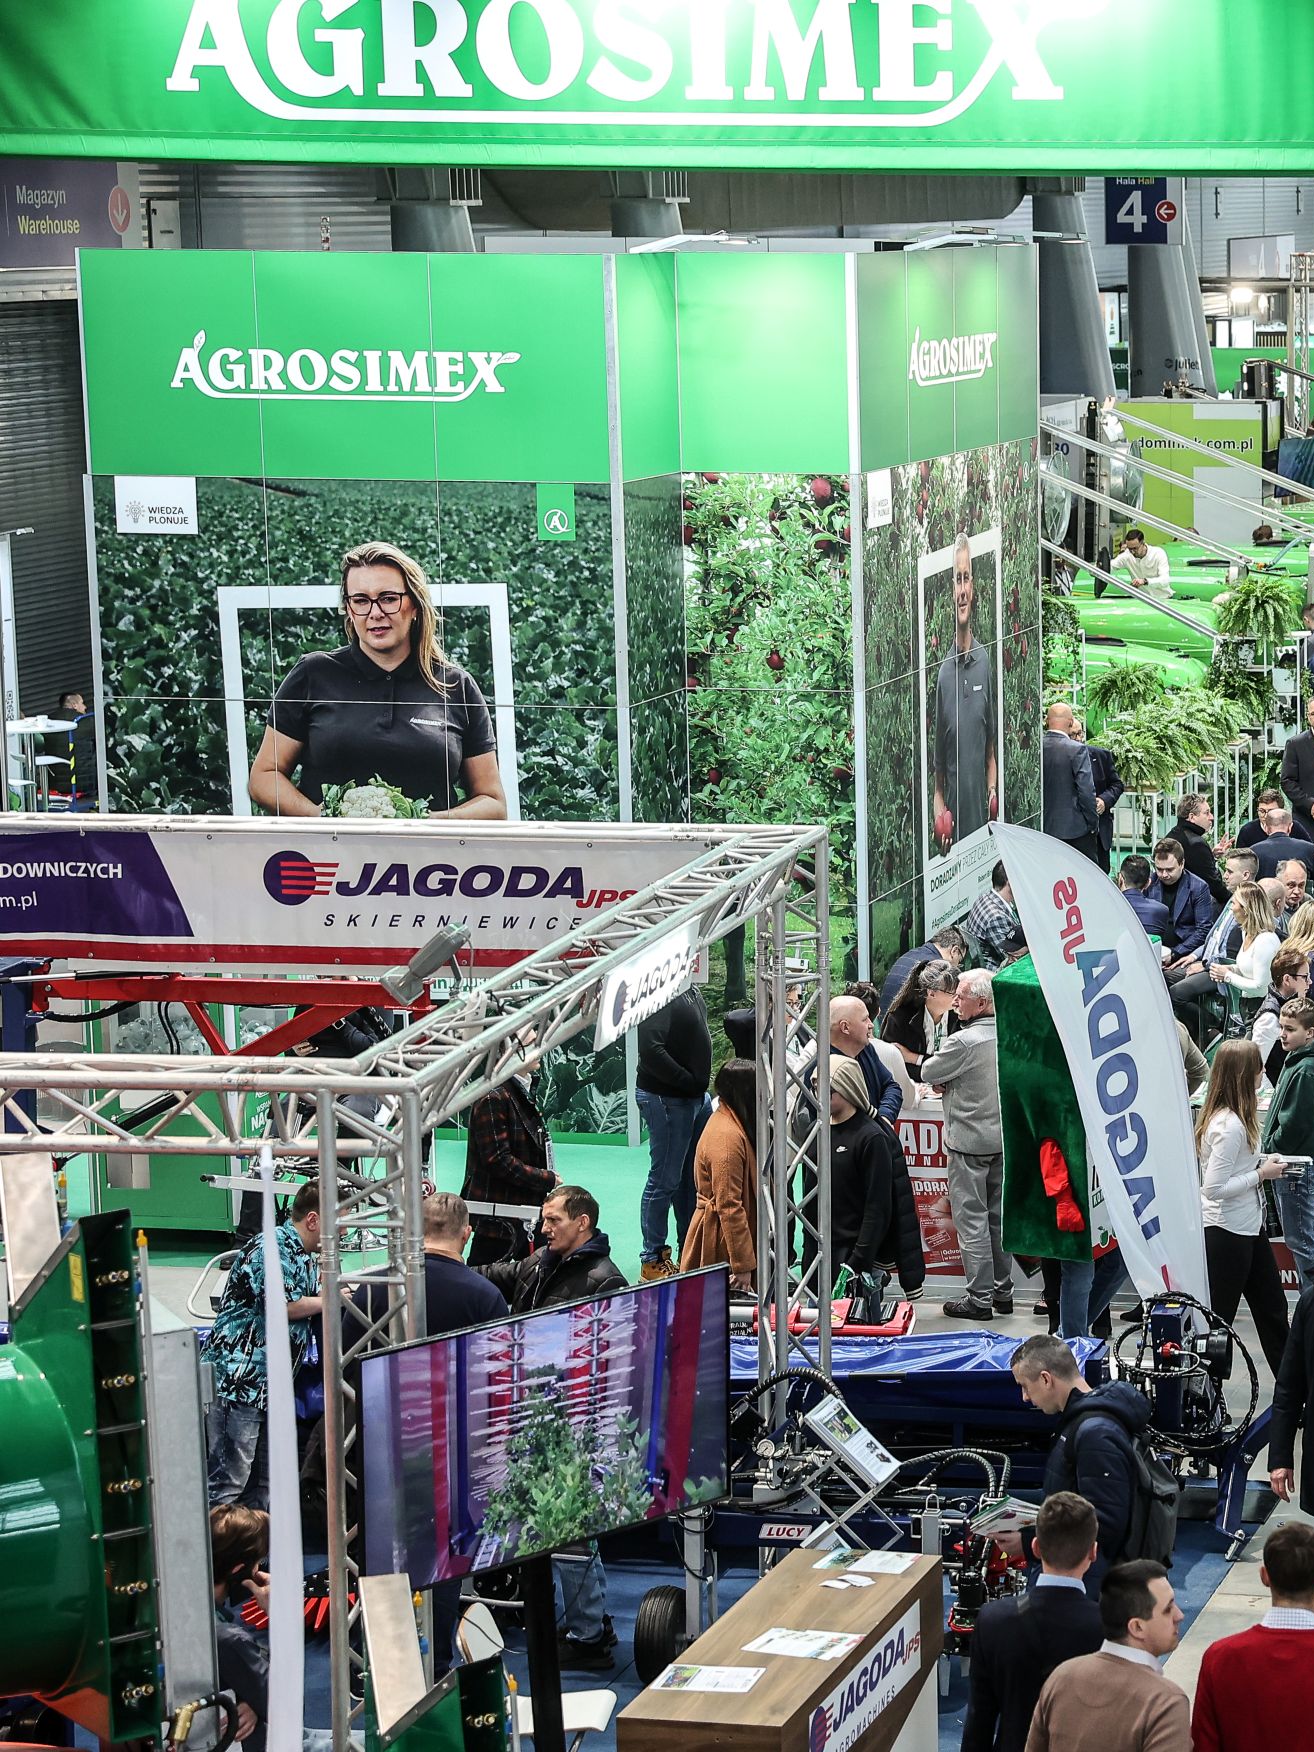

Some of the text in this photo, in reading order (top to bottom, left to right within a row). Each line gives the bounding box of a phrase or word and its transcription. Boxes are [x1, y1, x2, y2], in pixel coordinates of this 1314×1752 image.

[16, 185, 67, 209] Magazyn
[1116, 190, 1148, 233] 4
[17, 215, 81, 235] Warehouse
[171, 333, 515, 402] AGROSIMEX
[909, 327, 997, 387] AGROSIMEX
[148, 506, 184, 515] WIEDZA
[148, 516, 189, 525] PLONUJE
[0, 862, 123, 879] DOWNICZYCH
[335, 862, 585, 900] JAGODA
[766, 1526, 806, 1538] LUCY
[832, 1626, 920, 1733] JAGODA JPS
